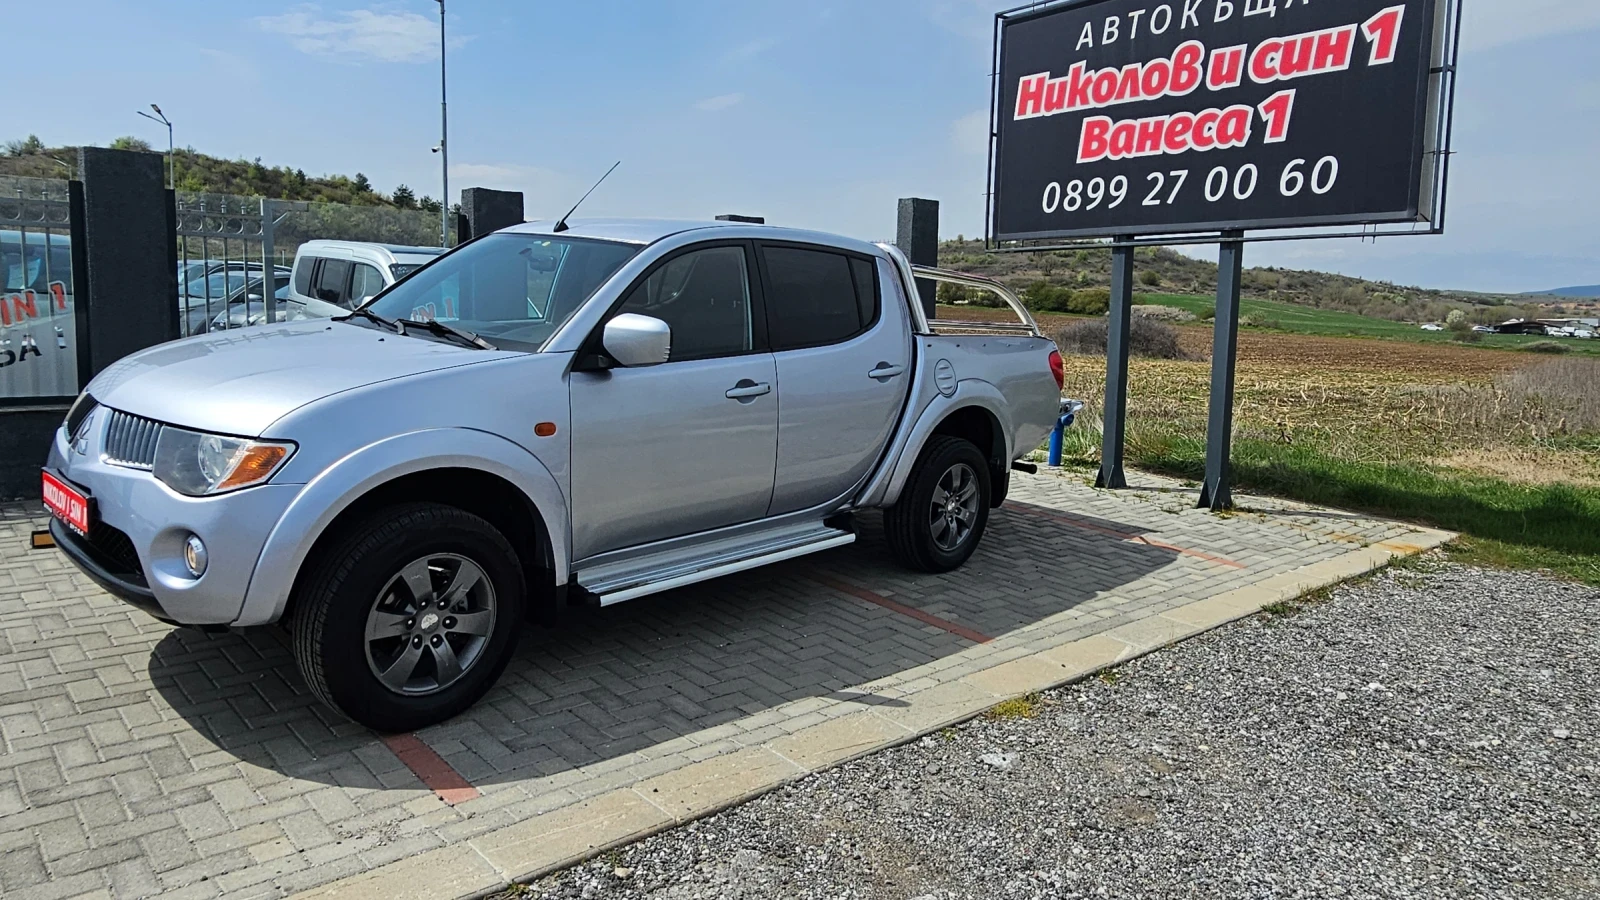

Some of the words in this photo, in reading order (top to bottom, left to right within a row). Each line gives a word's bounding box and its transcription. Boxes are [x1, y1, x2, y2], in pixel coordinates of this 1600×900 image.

[1014, 39, 1204, 120] Николов
[1205, 44, 1248, 91] и
[1248, 23, 1357, 84] син
[1362, 4, 1405, 66] 1
[1076, 105, 1254, 164] Ванеса
[1258, 89, 1296, 144] 1
[1042, 174, 1128, 214] 0899
[1141, 169, 1188, 206] 27
[1204, 163, 1258, 203] 00
[1279, 155, 1339, 197] 60
[48, 280, 67, 311] 1
[70, 498, 82, 523] SIN
[83, 506, 88, 527] 1
